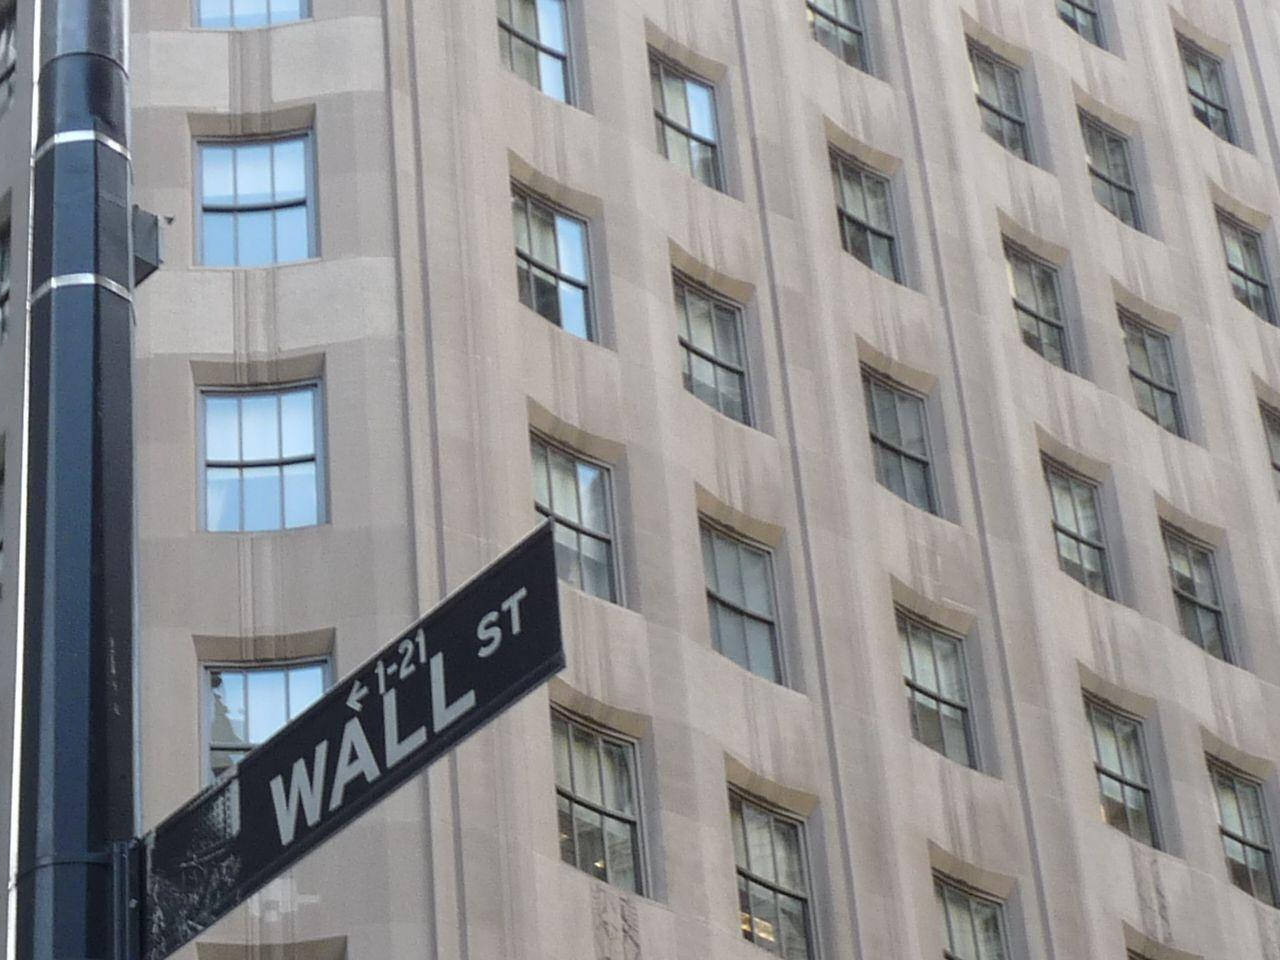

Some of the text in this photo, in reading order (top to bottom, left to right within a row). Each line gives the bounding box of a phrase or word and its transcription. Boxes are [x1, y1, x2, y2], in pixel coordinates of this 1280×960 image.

[270, 586, 528, 845] WALL ST
[374, 628, 426, 694] 1-21
